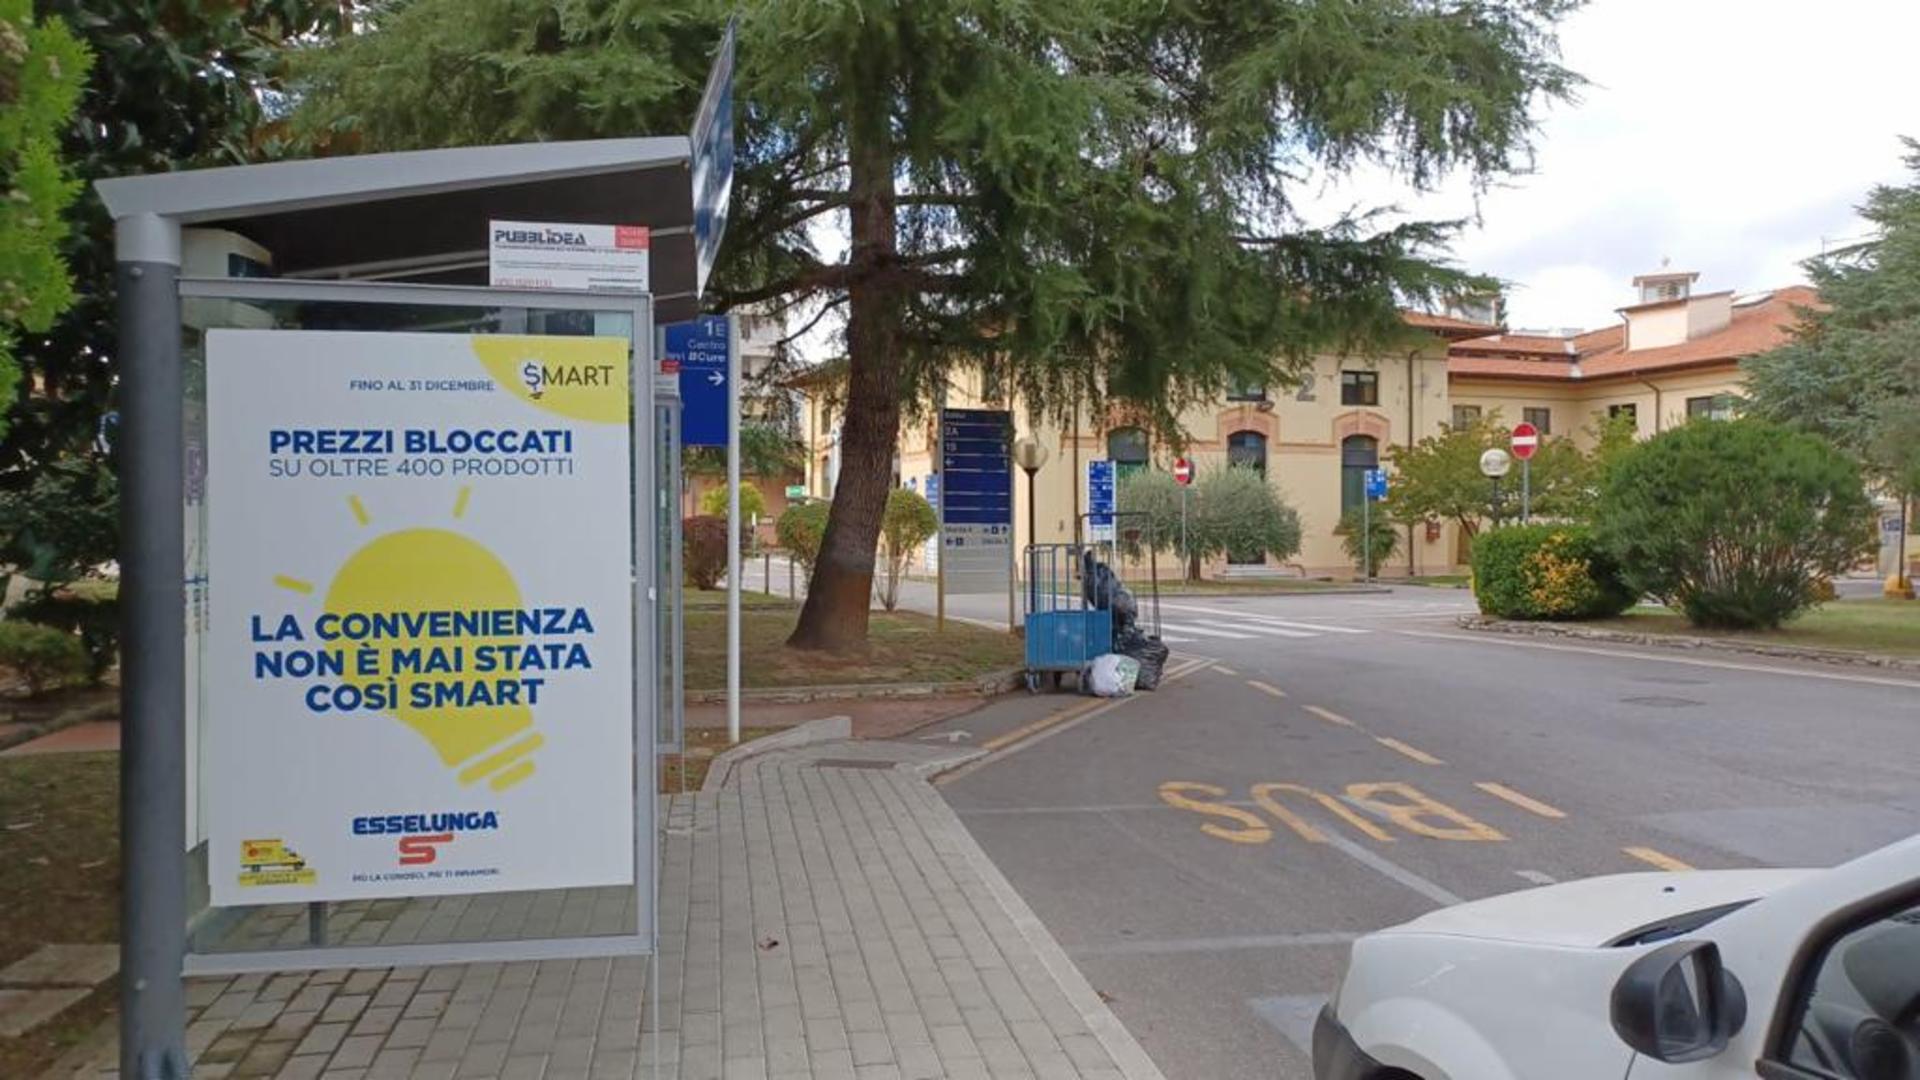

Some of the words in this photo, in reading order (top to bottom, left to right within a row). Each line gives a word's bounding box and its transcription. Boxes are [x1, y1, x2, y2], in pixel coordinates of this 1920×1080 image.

[705, 320, 726, 337] 1E
[350, 380, 383, 391] FINO
[387, 380, 405, 391] AL
[409, 380, 422, 391] 31
[425, 380, 495, 391] DICEMBRE
[1296, 372, 1316, 402] 2
[269, 430, 393, 454] PREZZI
[404, 430, 572, 454] BLOCCATI
[269, 458, 301, 477] SU
[308, 458, 389, 477] OLTRE
[396, 458, 445, 477] 400
[452, 457, 574, 476] PRODOTTI
[251, 614, 304, 642] LA
[314, 607, 595, 641] CONVENIENZA
[255, 651, 344, 679] NON
[357, 643, 380, 676] È
[391, 646, 463, 674] MAI
[475, 643, 592, 673] STATA
[305, 676, 399, 713] COSÌ
[409, 678, 545, 709] SMART
[352, 811, 499, 835] ESSELUNGA
[1157, 780, 1511, 844] BUS
